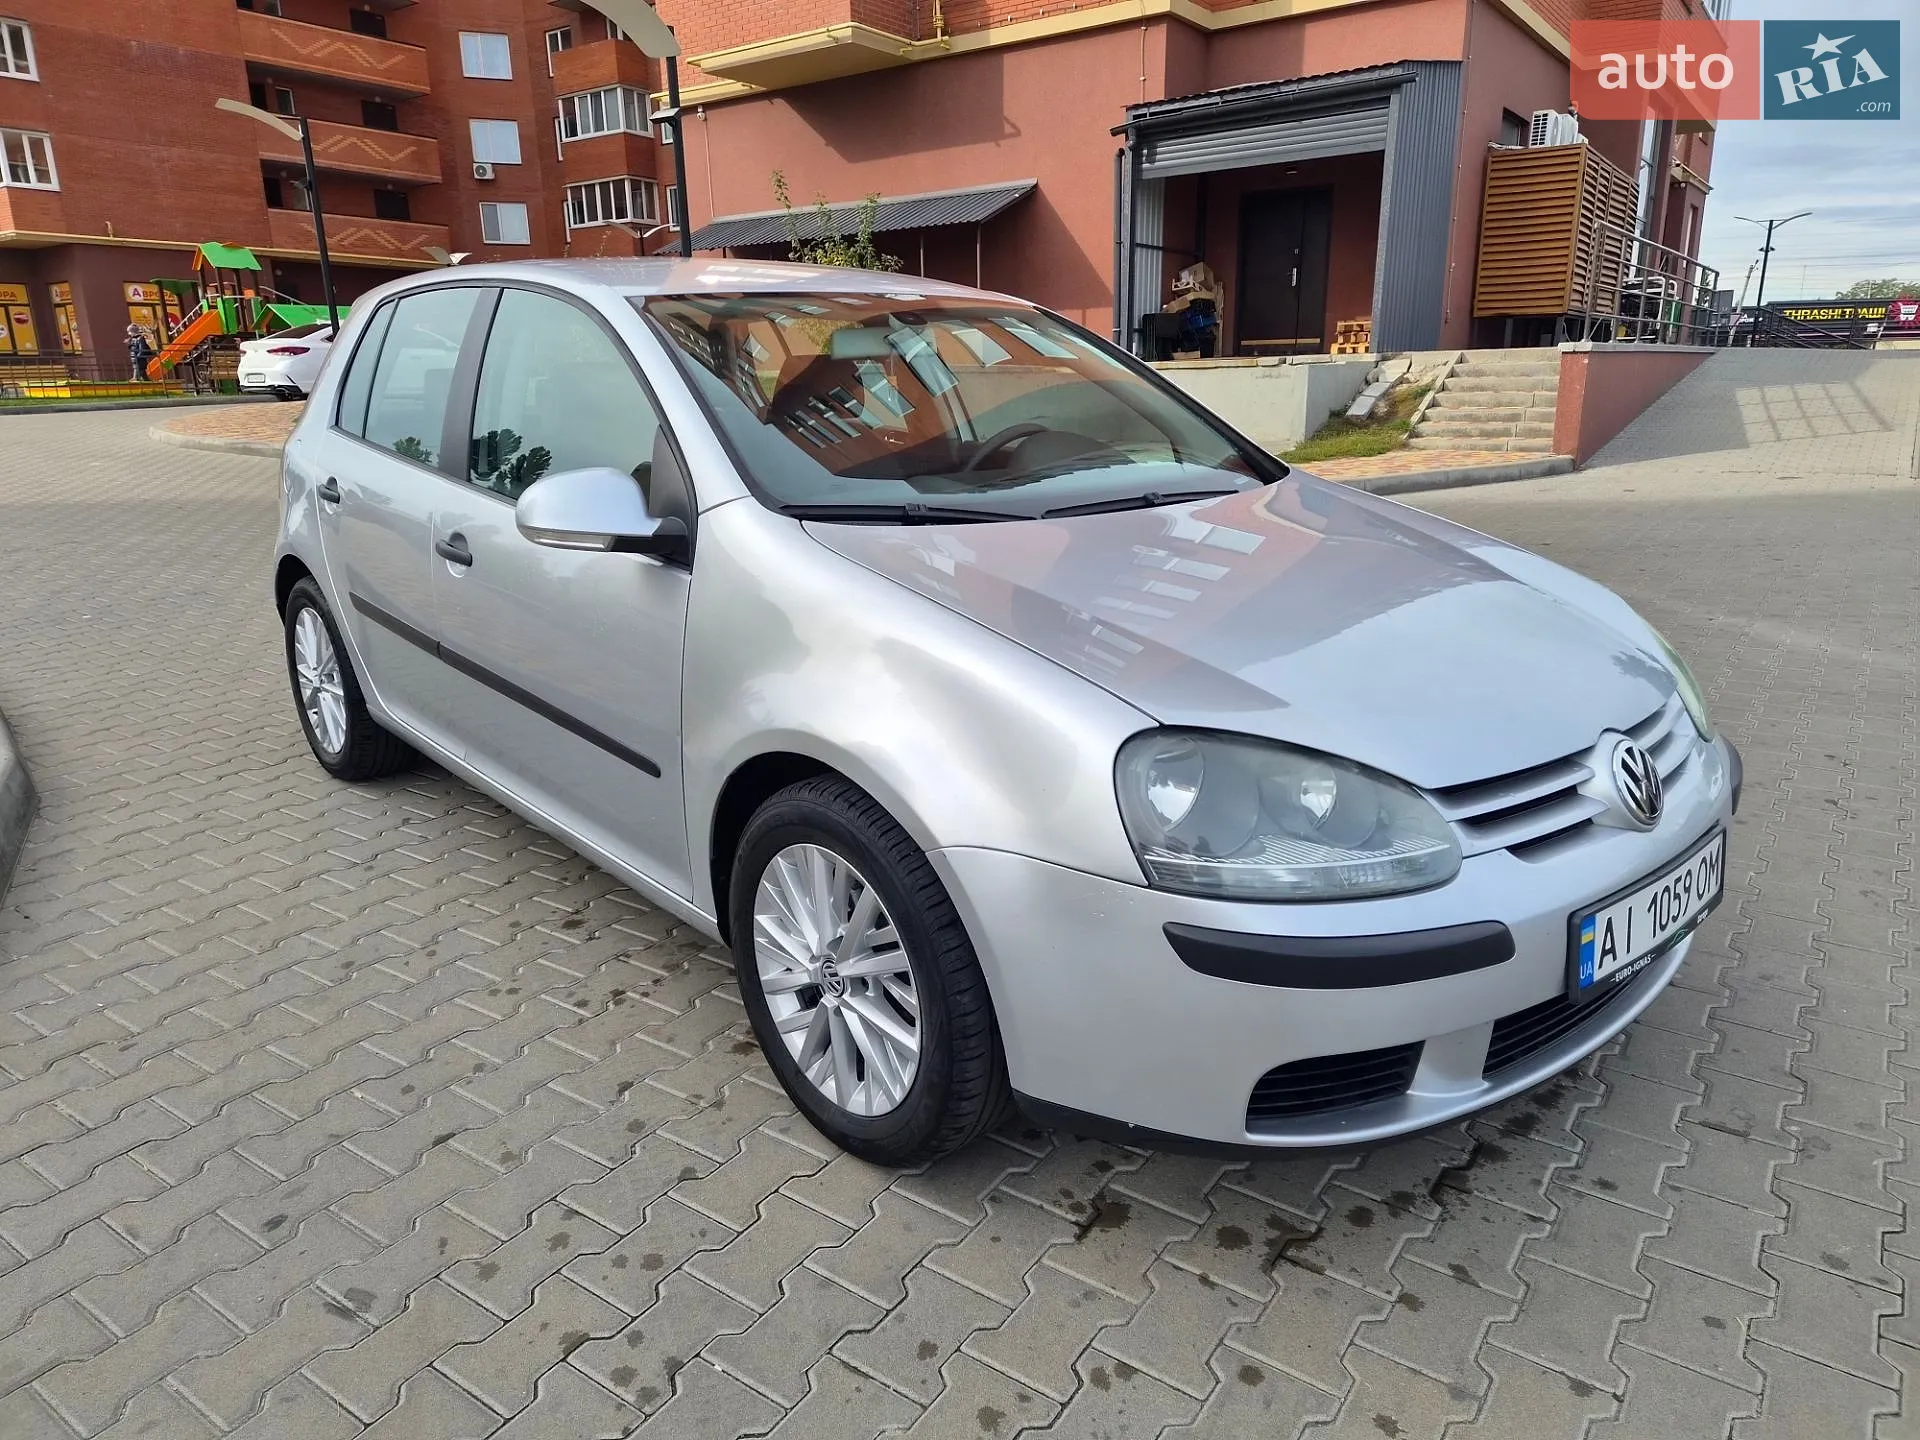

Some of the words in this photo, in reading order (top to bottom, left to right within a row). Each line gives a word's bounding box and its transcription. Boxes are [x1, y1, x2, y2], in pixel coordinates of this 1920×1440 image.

[1598, 906, 1633, 970] AI
[1647, 868, 1693, 939] 1059
[1696, 843, 1721, 900] OM
[1580, 961, 1593, 979] UA
